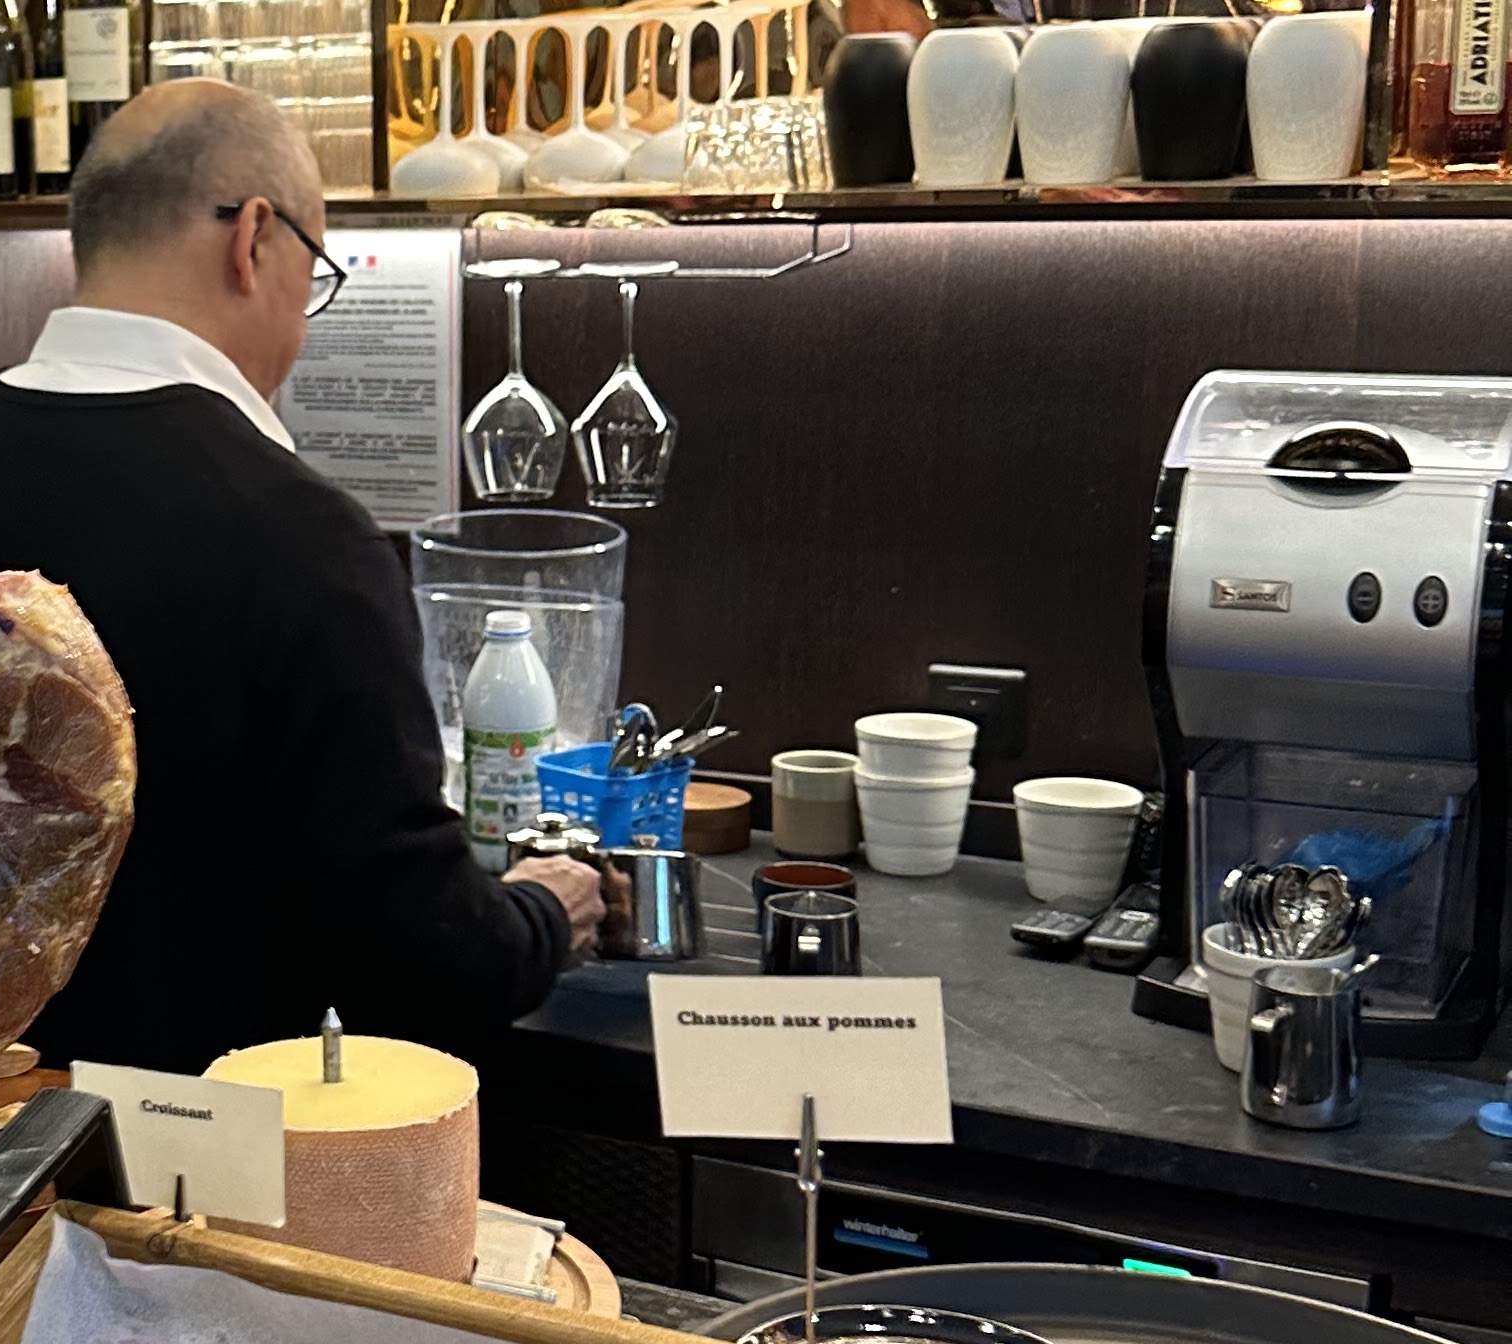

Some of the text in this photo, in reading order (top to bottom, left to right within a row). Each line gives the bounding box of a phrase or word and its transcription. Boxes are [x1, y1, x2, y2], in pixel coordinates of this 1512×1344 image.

[677, 1011, 917, 1032] Chausson aux pommes
[141, 1098, 214, 1121] Croissant
